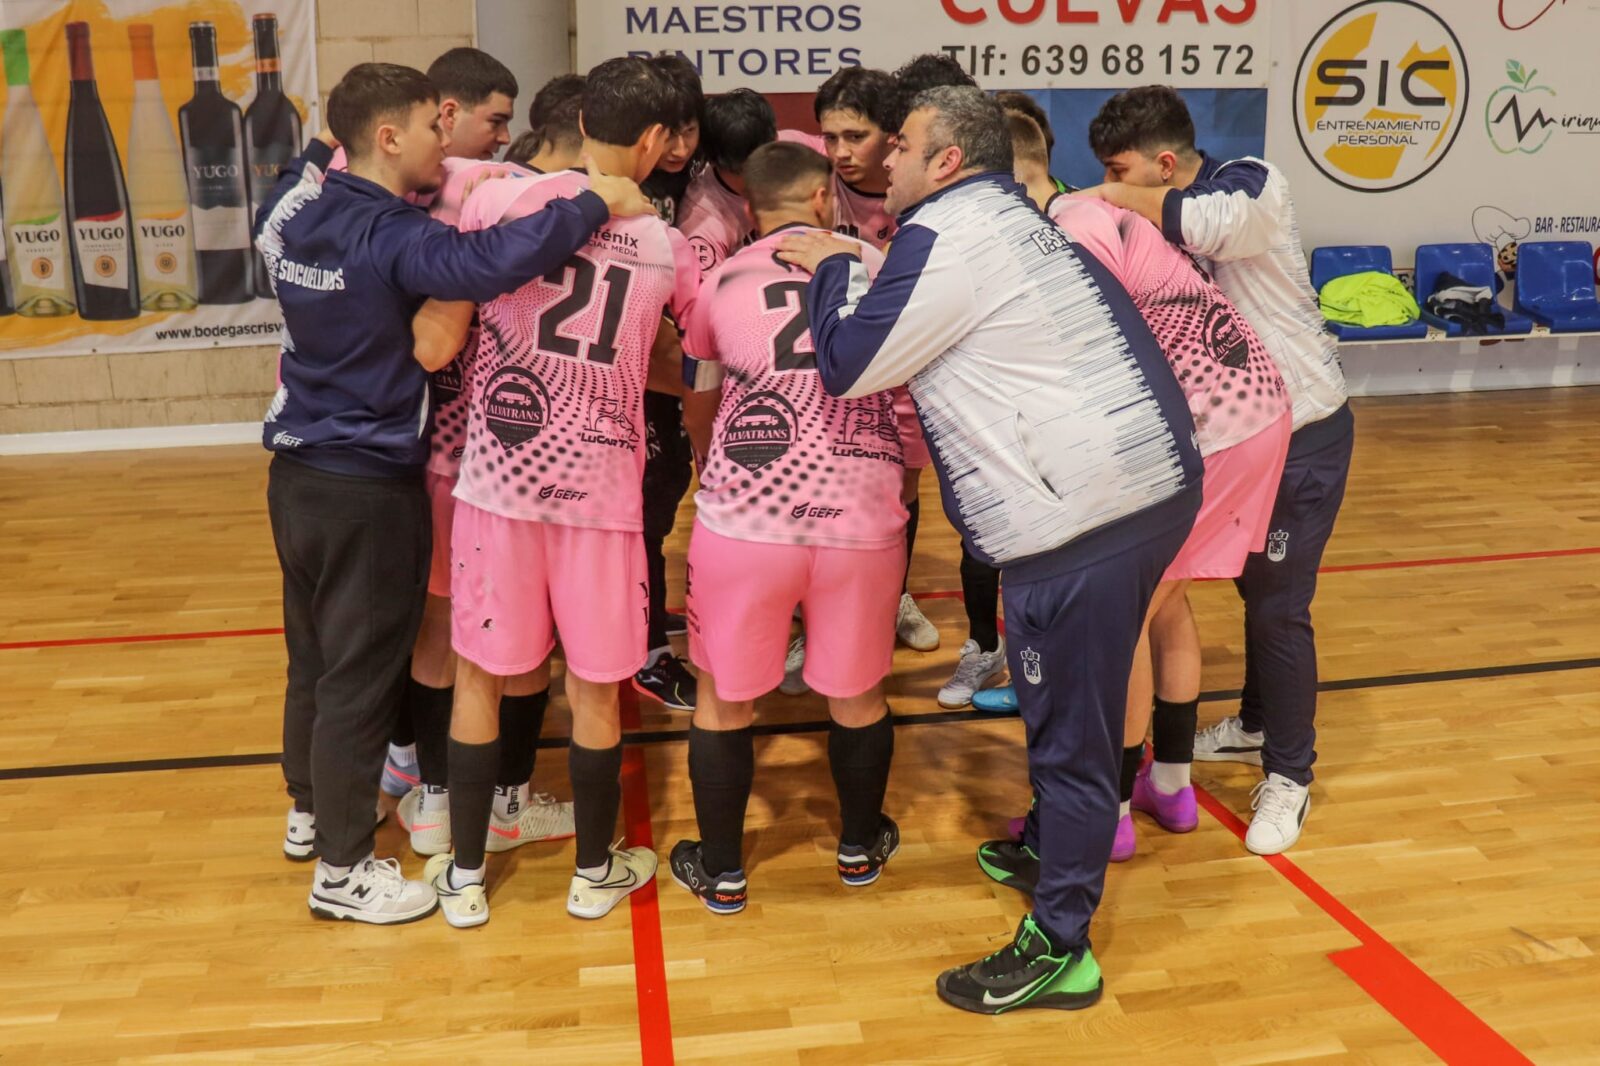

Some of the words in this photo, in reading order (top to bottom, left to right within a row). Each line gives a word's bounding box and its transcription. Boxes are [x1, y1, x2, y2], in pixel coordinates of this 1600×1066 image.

[626, 5, 862, 34] MAESTROS
[627, 48, 862, 76] NTORES
[942, 45, 1006, 76] Tlf:
[1021, 44, 1088, 76] 639
[1101, 44, 1144, 76] 68
[1158, 44, 1201, 76] 15
[1213, 44, 1254, 76] 72
[1315, 60, 1450, 106] SIC
[1316, 120, 1441, 131] ENTRENAMIENTO
[1338, 135, 1418, 145] PERSONAL
[193, 164, 239, 179] YUGO
[255, 164, 281, 177] YUG
[141, 225, 185, 238] YUGO
[1535, 217, 1553, 233] BAR
[15, 229, 60, 244] YUGO
[79, 227, 125, 240] YUGO
[611, 244, 639, 258] MEDIA
[537, 254, 632, 366] 21
[726, 429, 788, 442] ALVATRANS
[554, 488, 588, 501] GEFF
[808, 506, 844, 519] GEFF
